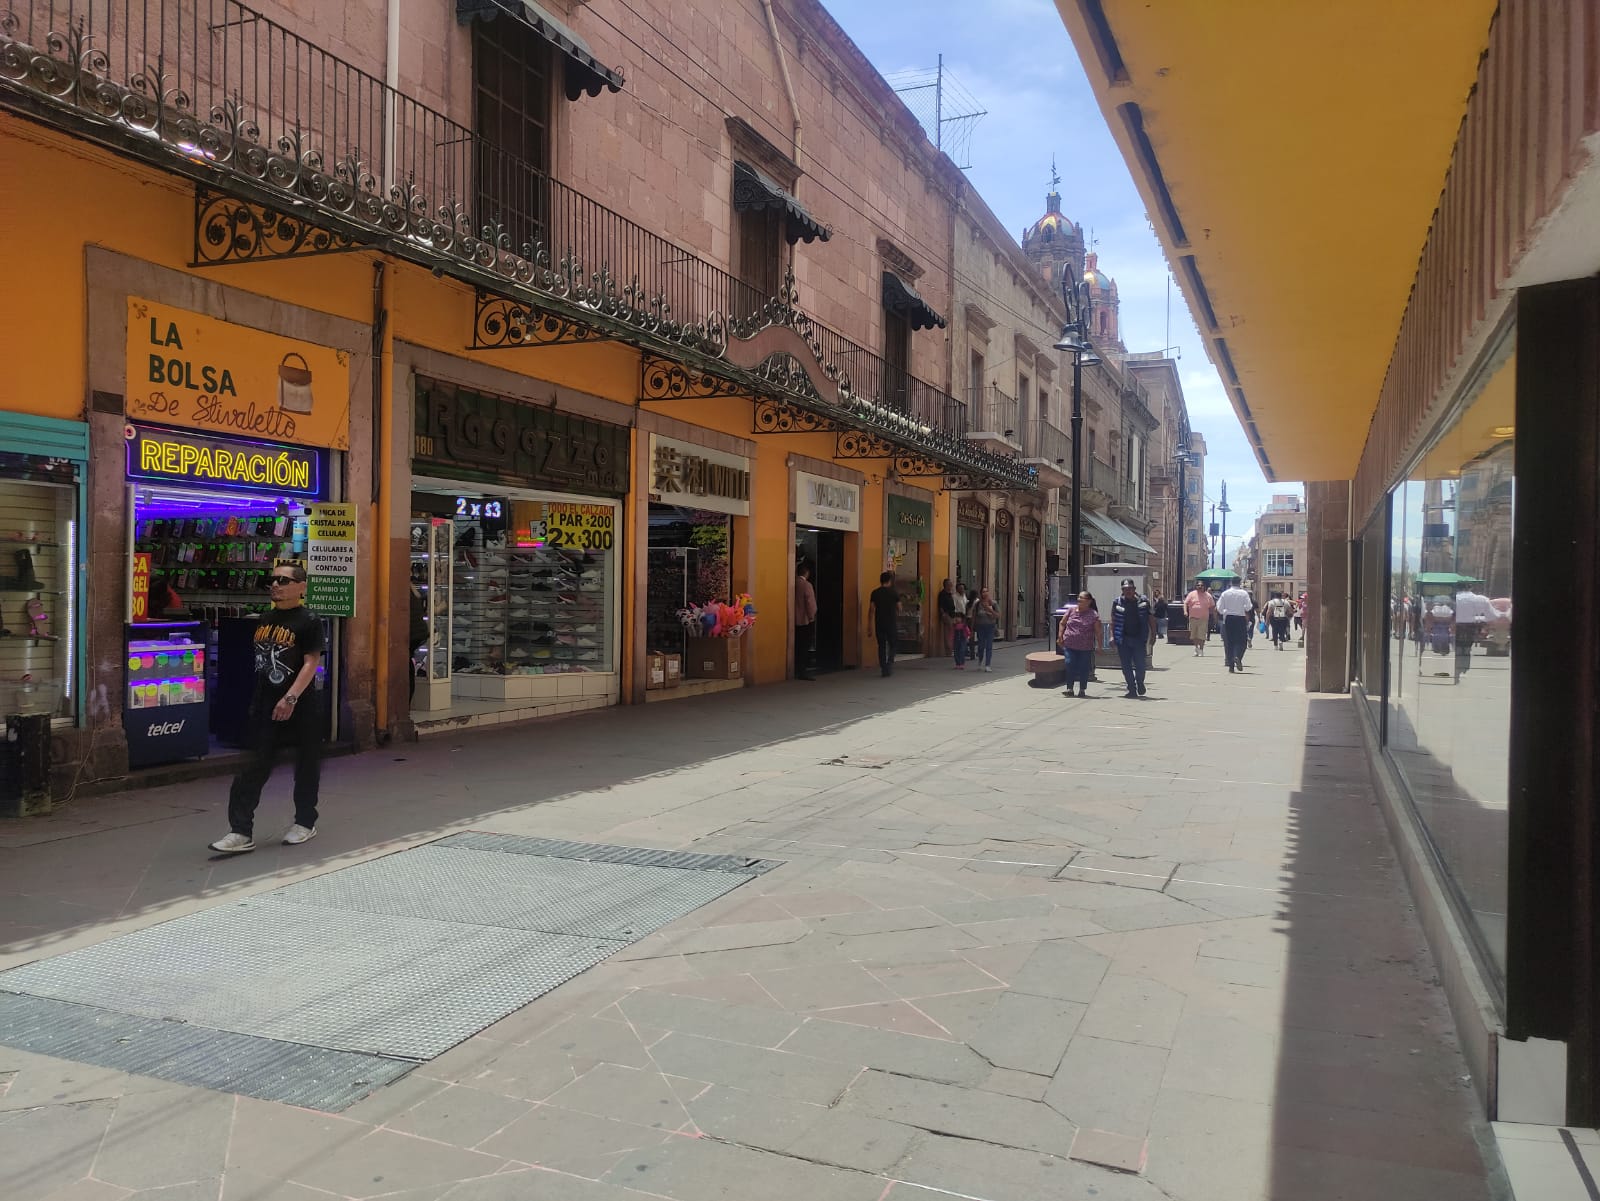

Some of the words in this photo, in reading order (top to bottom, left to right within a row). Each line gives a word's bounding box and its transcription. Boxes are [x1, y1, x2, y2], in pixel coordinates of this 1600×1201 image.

[150, 317, 183, 350] LA
[149, 354, 237, 397] BOLSA
[147, 392, 179, 416] De
[192, 395, 296, 438] Stivaletto
[415, 435, 433, 455] 180
[141, 439, 309, 488] REPARACIÓN
[456, 497, 467, 515] 2
[570, 503, 579, 514] EL
[310, 519, 336, 527] CRISTAL
[548, 512, 555, 525] 1
[560, 513, 583, 526] PAR
[586, 515, 611, 528] $200
[317, 529, 347, 537] CELULAR
[548, 528, 563, 548] 2
[578, 529, 613, 550] $300
[315, 564, 348, 572] CONTADO
[311, 594, 344, 602] PANTALLA
[309, 603, 350, 612] DESBLOQUEO
[147, 719, 185, 737] telcel
